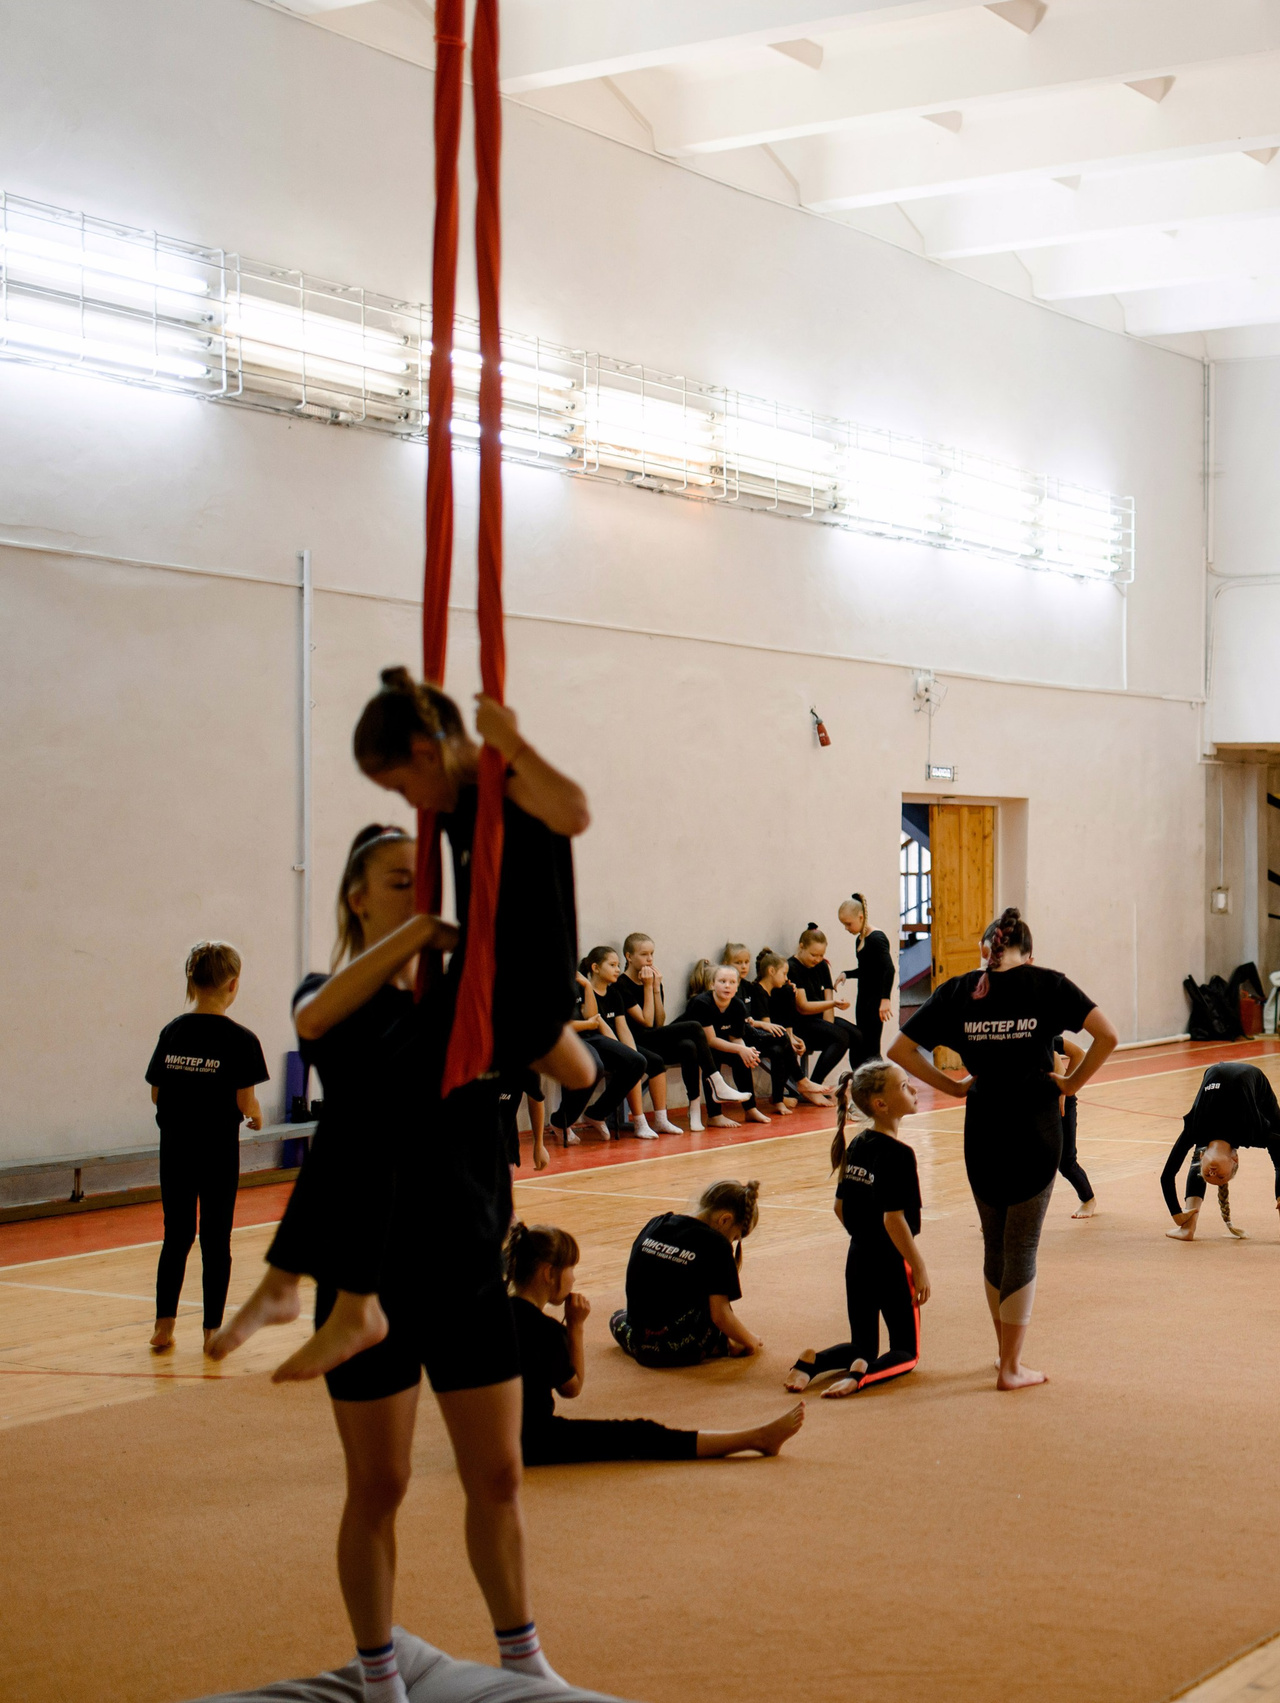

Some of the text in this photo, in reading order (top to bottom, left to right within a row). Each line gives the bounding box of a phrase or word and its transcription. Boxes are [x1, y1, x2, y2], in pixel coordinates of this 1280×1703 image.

[964, 1018, 1038, 1033] МИСТЕР МО
[165, 1054, 220, 1068] МИСТЕР МО
[642, 1238, 696, 1261] МИСТЕР МО
